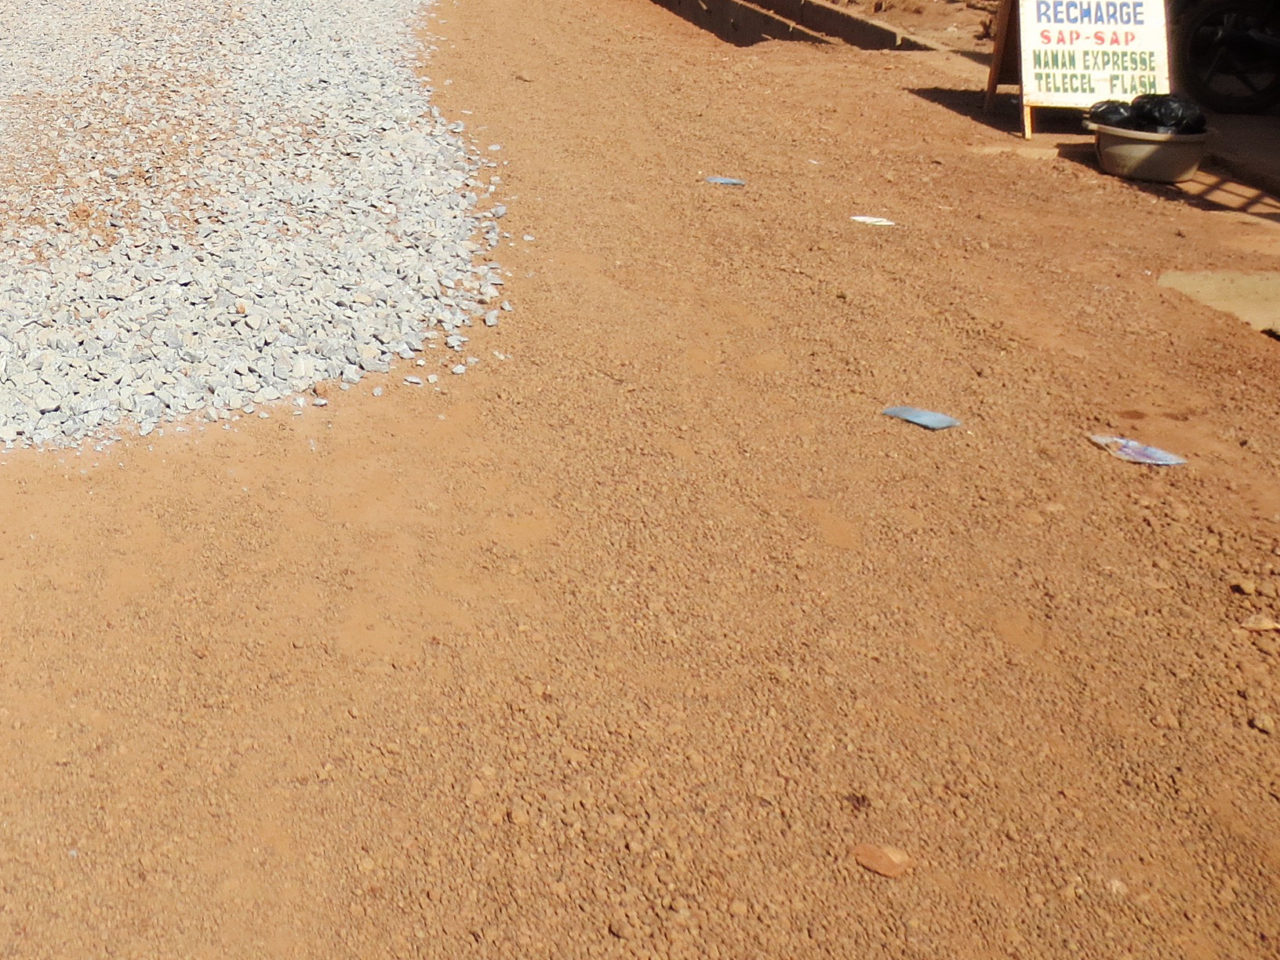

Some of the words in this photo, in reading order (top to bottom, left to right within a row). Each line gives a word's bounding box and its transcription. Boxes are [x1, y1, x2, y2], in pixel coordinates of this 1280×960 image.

[1036, 0, 1144, 25] RECHARGE
[1082, 50, 1156, 72] EXPRESSE
[1034, 72, 1095, 94] TELECEL
[1109, 74, 1157, 95] FLASH
